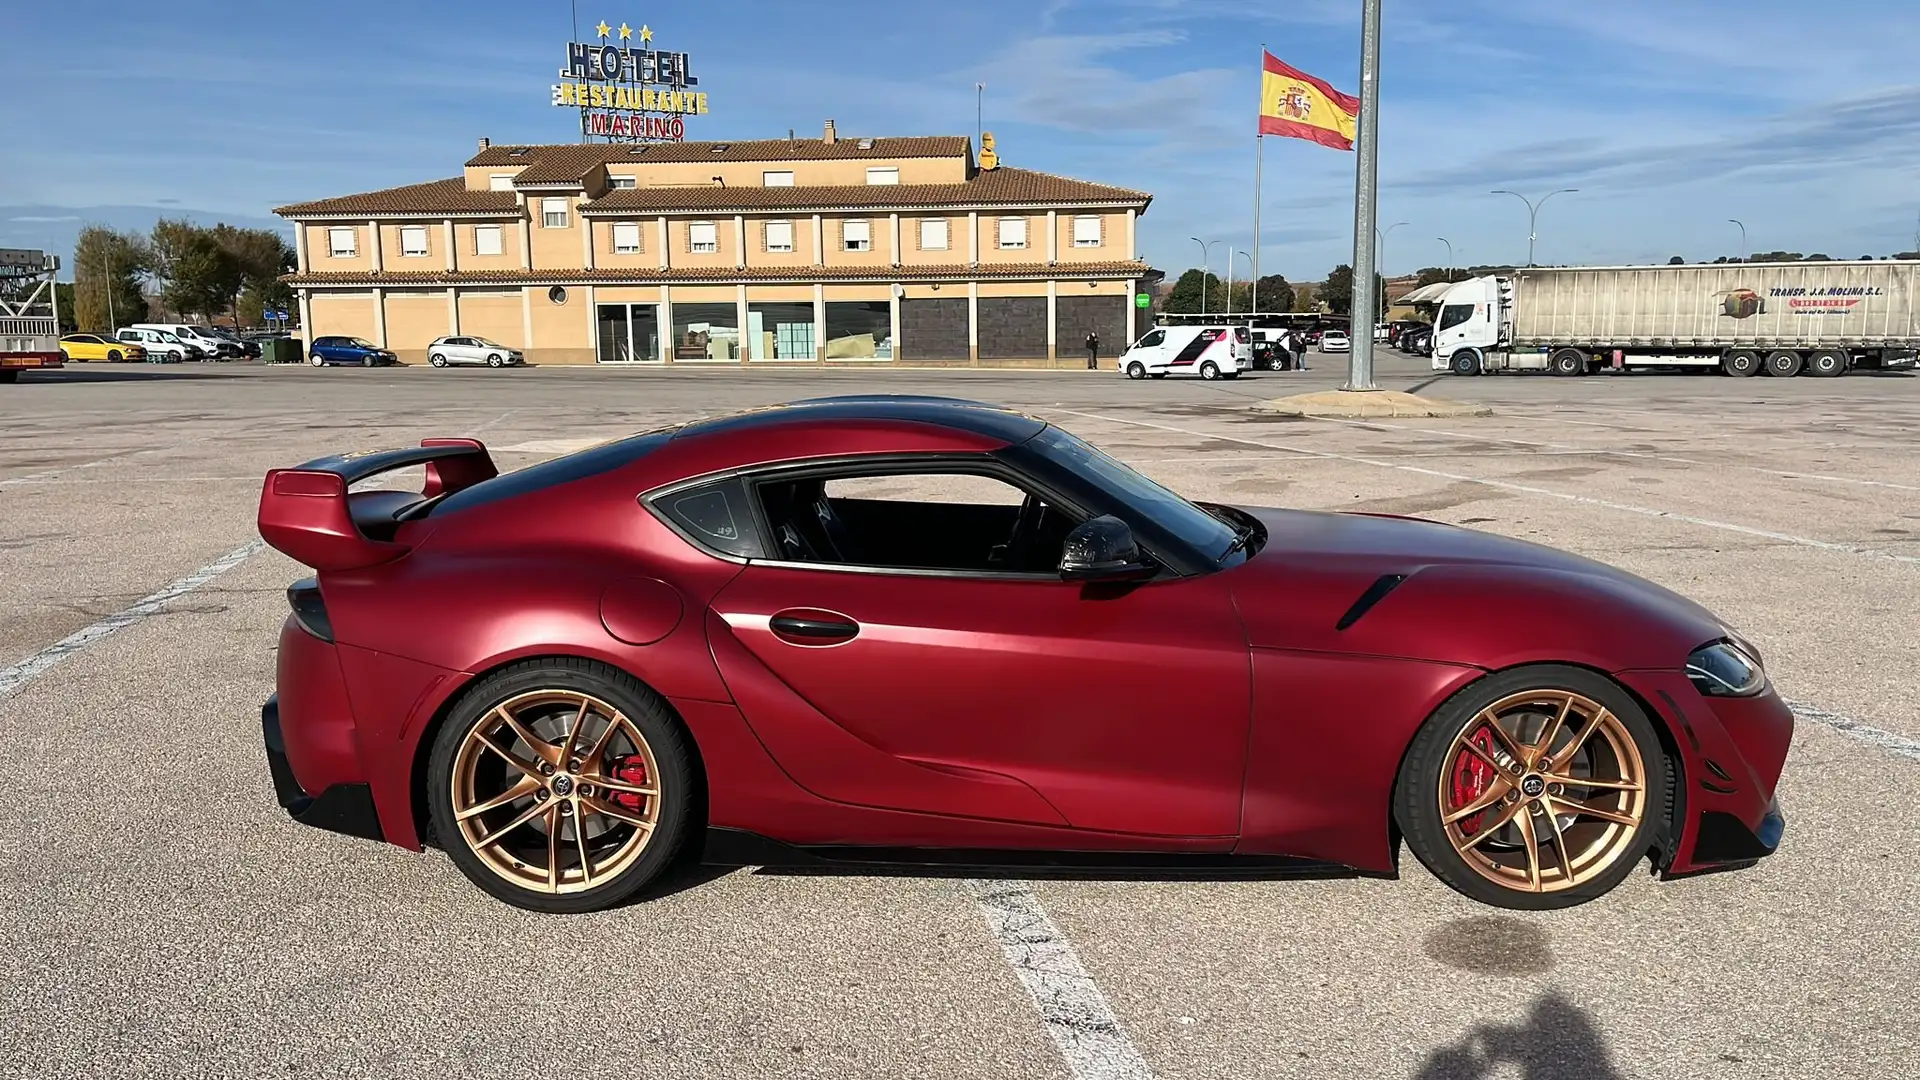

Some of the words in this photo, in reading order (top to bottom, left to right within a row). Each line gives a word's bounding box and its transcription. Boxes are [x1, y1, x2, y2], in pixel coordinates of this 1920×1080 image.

[567, 42, 698, 85] HOTEL
[560, 83, 708, 114] RESTAURANTE
[590, 113, 685, 139] MARINO
[1770, 288, 1806, 296] TRANSP.
[1827, 287, 1864, 296] MOLINA
[1865, 287, 1883, 296] S.L.
